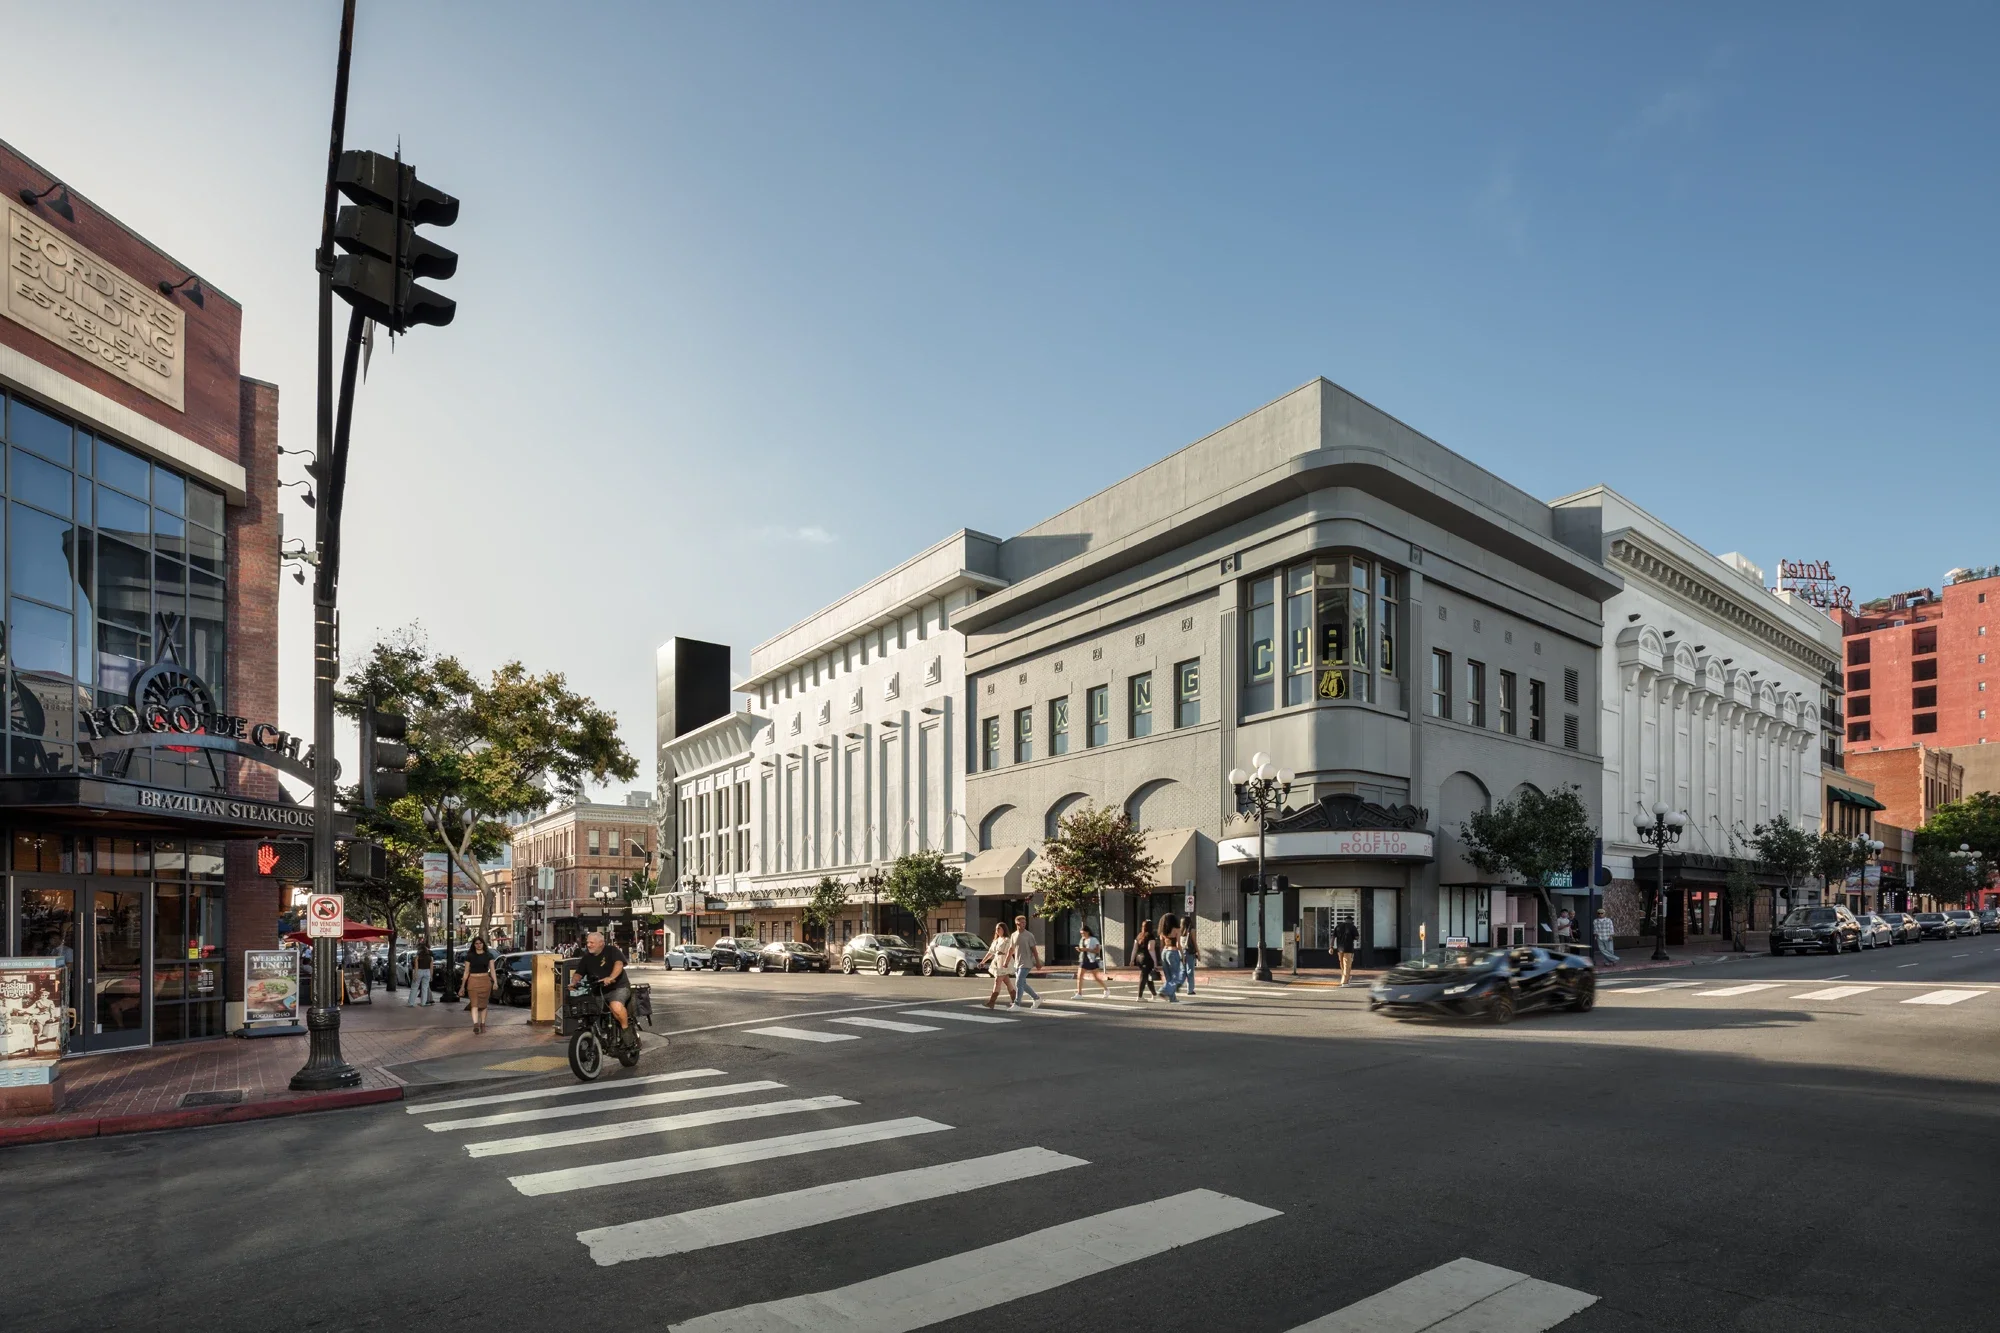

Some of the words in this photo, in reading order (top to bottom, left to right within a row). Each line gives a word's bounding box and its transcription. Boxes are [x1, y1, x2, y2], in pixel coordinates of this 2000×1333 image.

[12, 216, 176, 335] BORDERS
[12, 248, 175, 359] BUILDING
[16, 279, 172, 377] ESTABLISHED
[68, 327, 129, 372] 2002
[80, 704, 199, 740] FOGO
[215, 713, 247, 739] DE
[990, 666, 1200, 751] BOXING
[138, 790, 225, 816] BRAZILIAN
[229, 803, 315, 827] STEAKHOUS
[1352, 832, 1400, 843] CIELO
